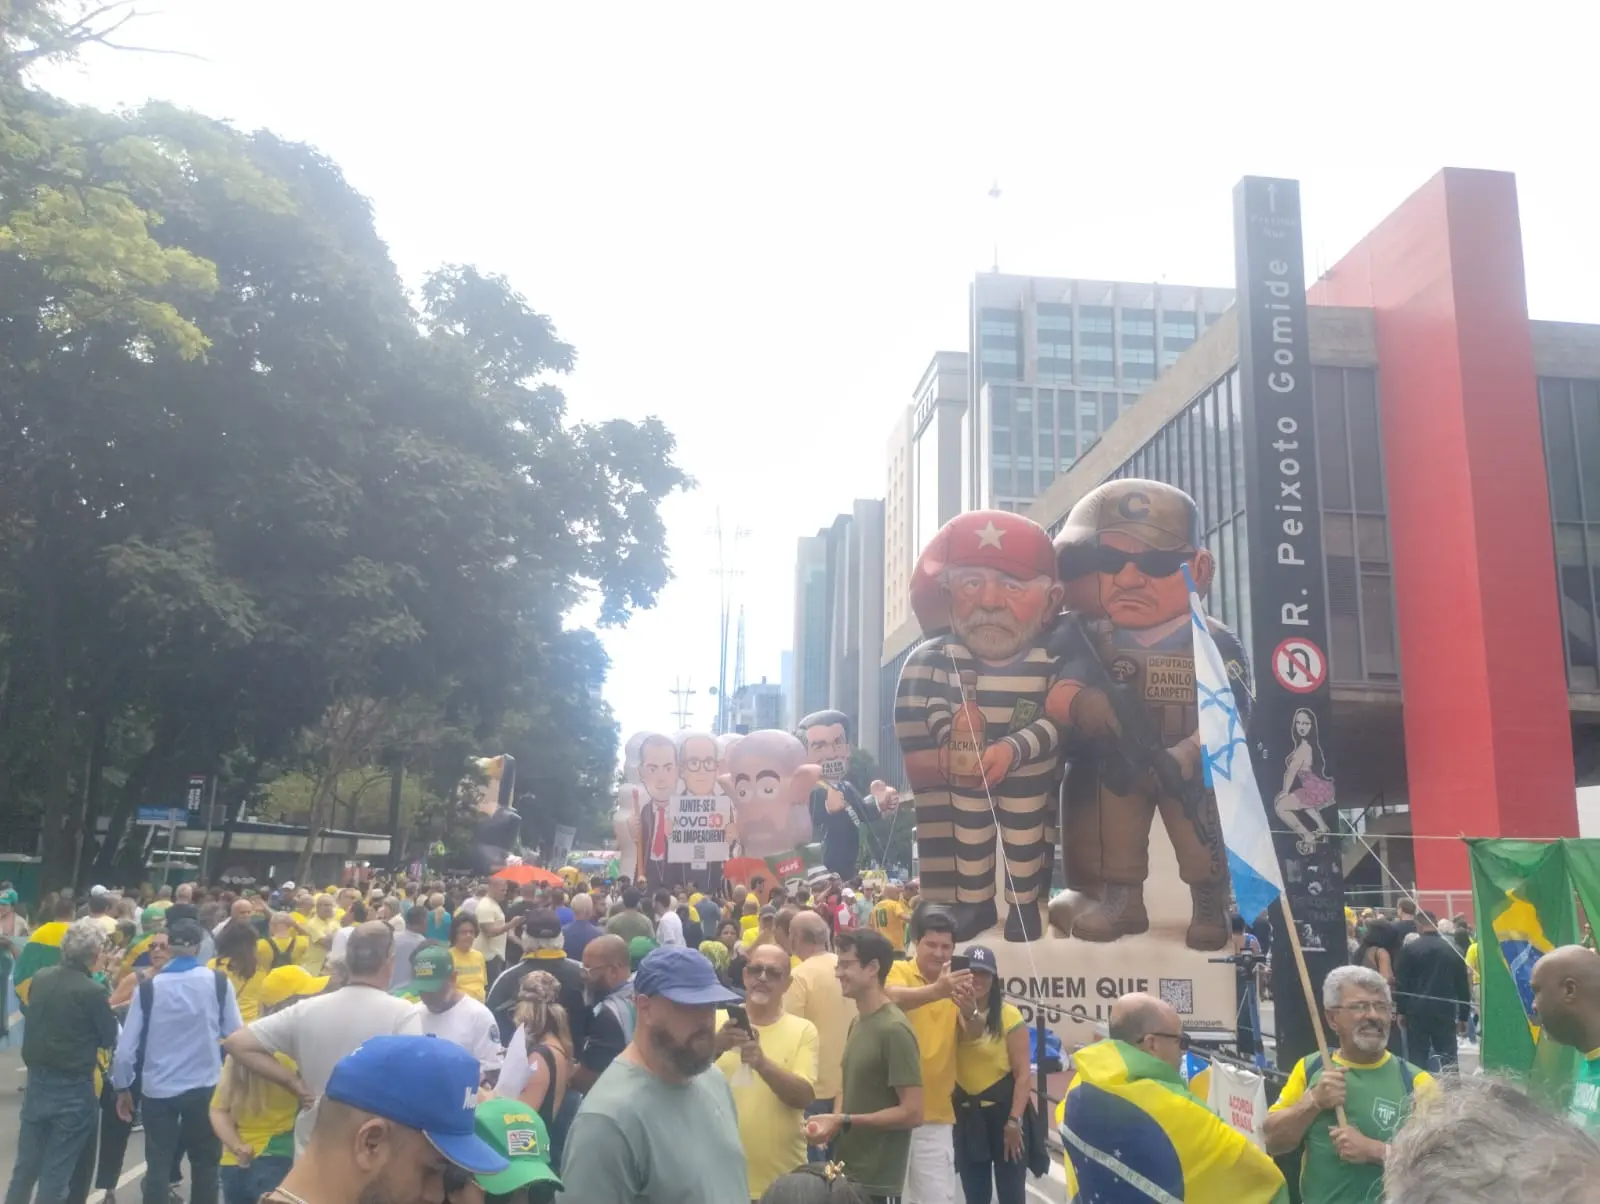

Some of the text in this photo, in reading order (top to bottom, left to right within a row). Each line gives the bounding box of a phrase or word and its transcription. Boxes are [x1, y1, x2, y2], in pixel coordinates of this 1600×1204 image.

[1265, 259, 1309, 626] R. Peixoto Gomide
[1149, 656, 1194, 668] DEPUTADO
[1151, 672, 1192, 686] DANILO
[1096, 976, 1149, 999] QUE
